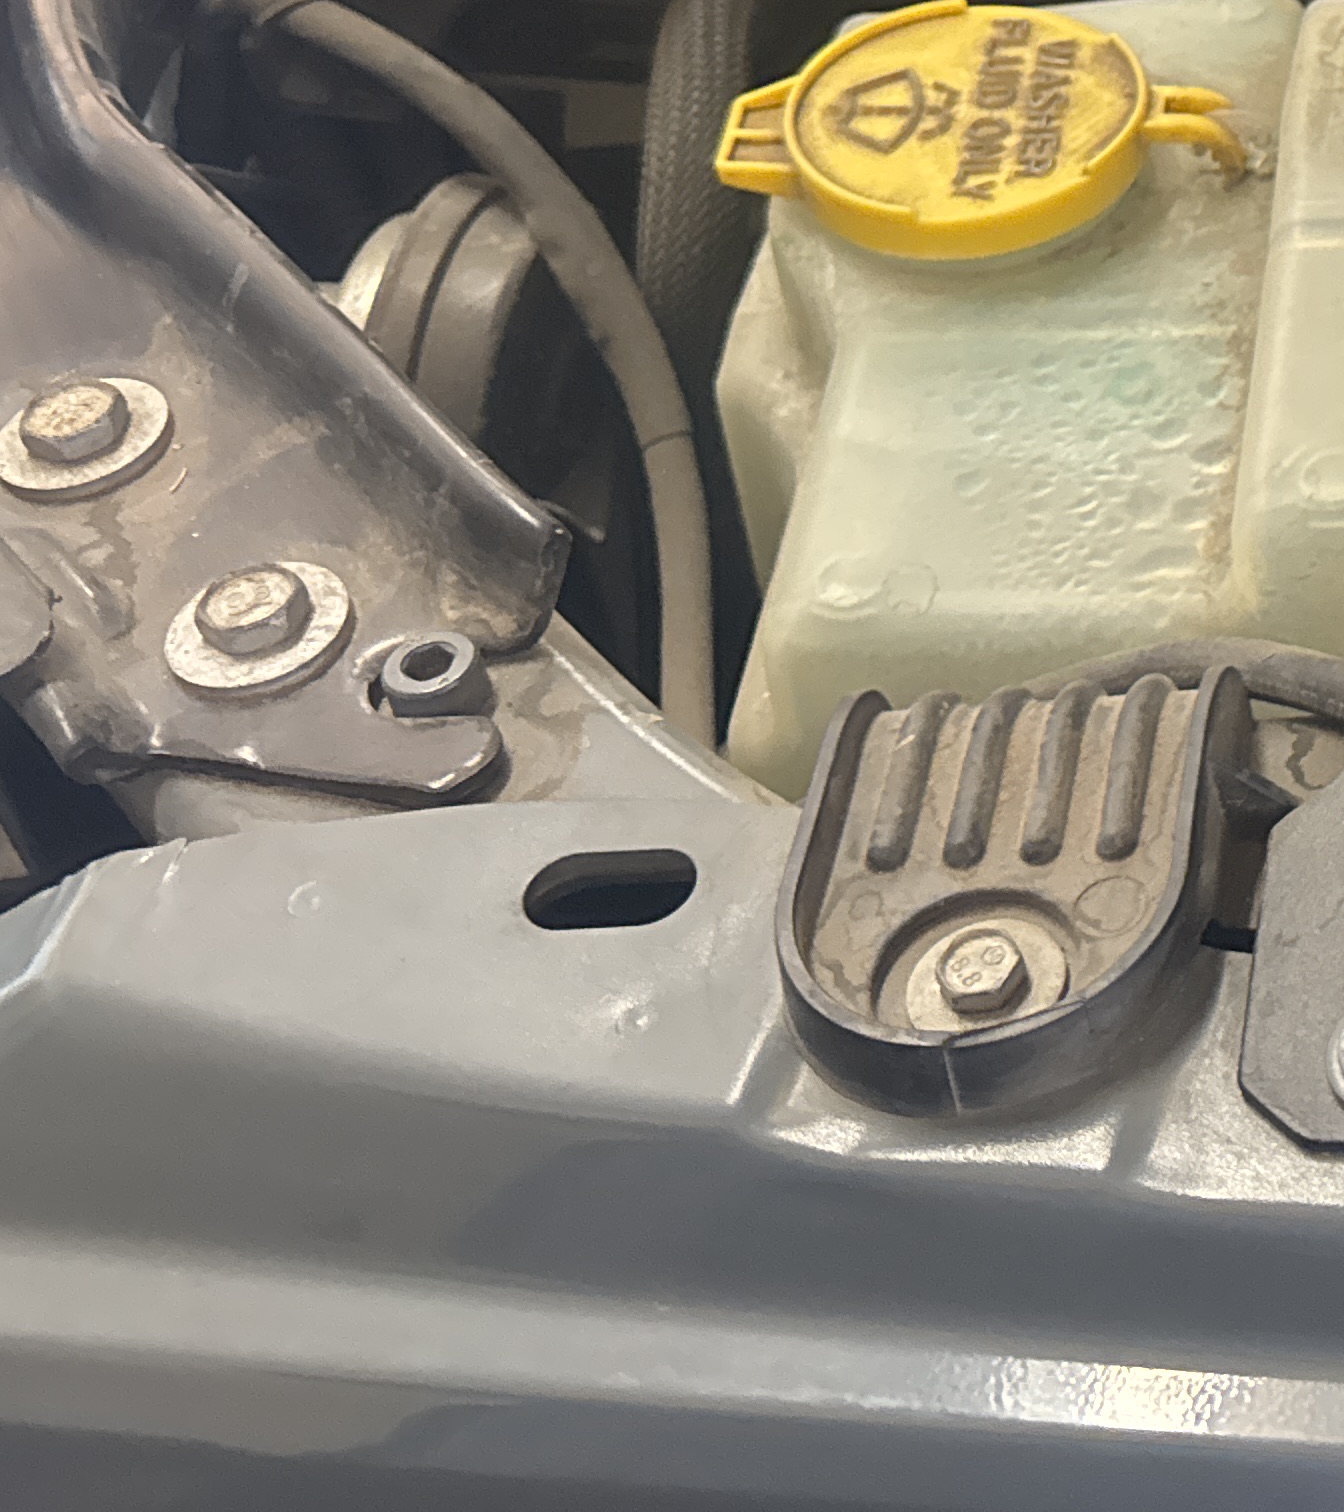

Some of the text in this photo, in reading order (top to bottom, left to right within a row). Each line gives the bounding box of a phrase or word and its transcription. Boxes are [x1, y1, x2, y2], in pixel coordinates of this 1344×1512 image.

[951, 18, 1032, 201] FLUID ONLY
[1006, 39, 1079, 185] WASHER
